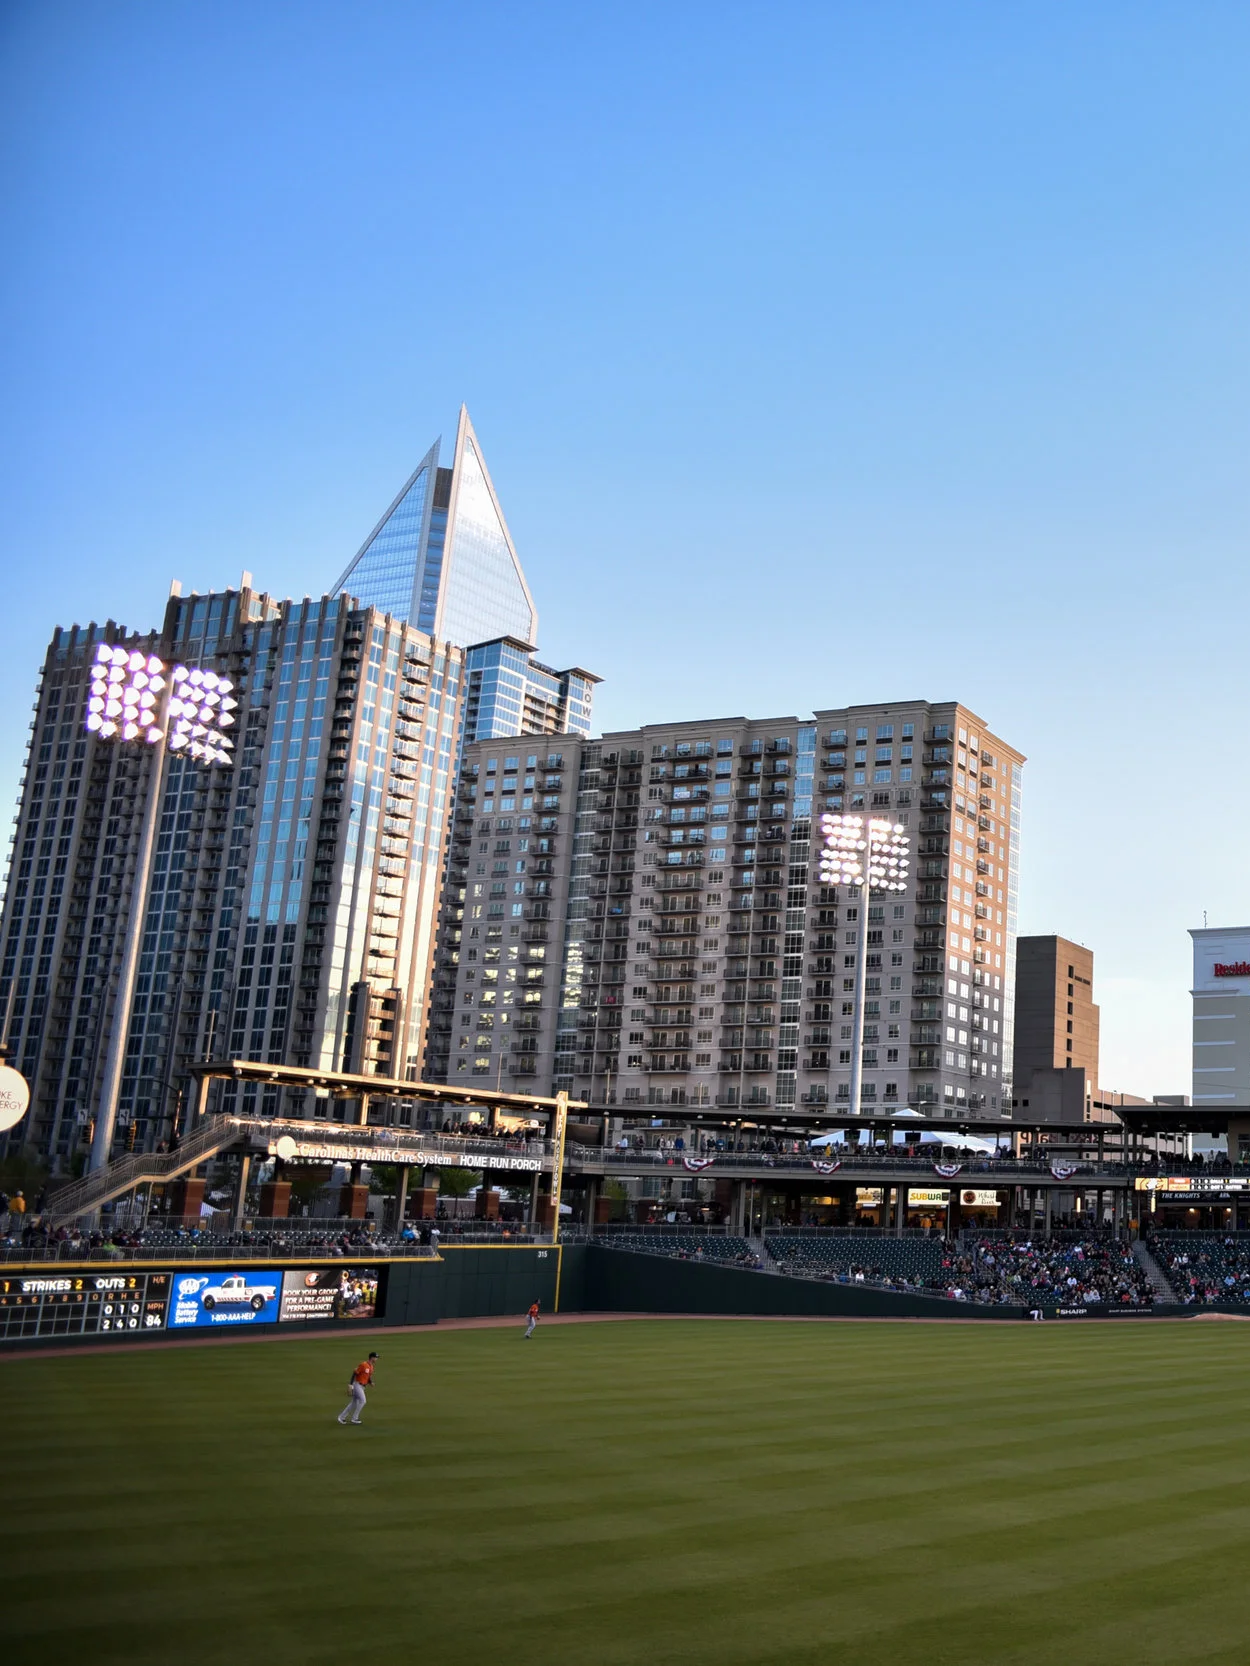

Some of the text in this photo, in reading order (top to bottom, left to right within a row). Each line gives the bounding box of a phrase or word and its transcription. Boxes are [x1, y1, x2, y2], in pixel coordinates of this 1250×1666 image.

[300, 1144, 542, 1171] Carolinas HealthCare System HOME RUN PORCH
[909, 1192, 945, 1201] SUBWA
[538, 1250, 548, 1258] 315
[4, 1277, 136, 1293] 1 STRIKES 2 OUTS 2
[121, 1292, 127, 1300] H
[283, 1289, 301, 1297] BOOK
[104, 1304, 139, 1315] 0 1 0
[147, 1302, 164, 1310] MPH
[176, 1309, 199, 1317] Battery
[103, 1318, 137, 1329] 2 4 0
[146, 1314, 162, 1327] 84
[174, 1316, 197, 1324] Service
